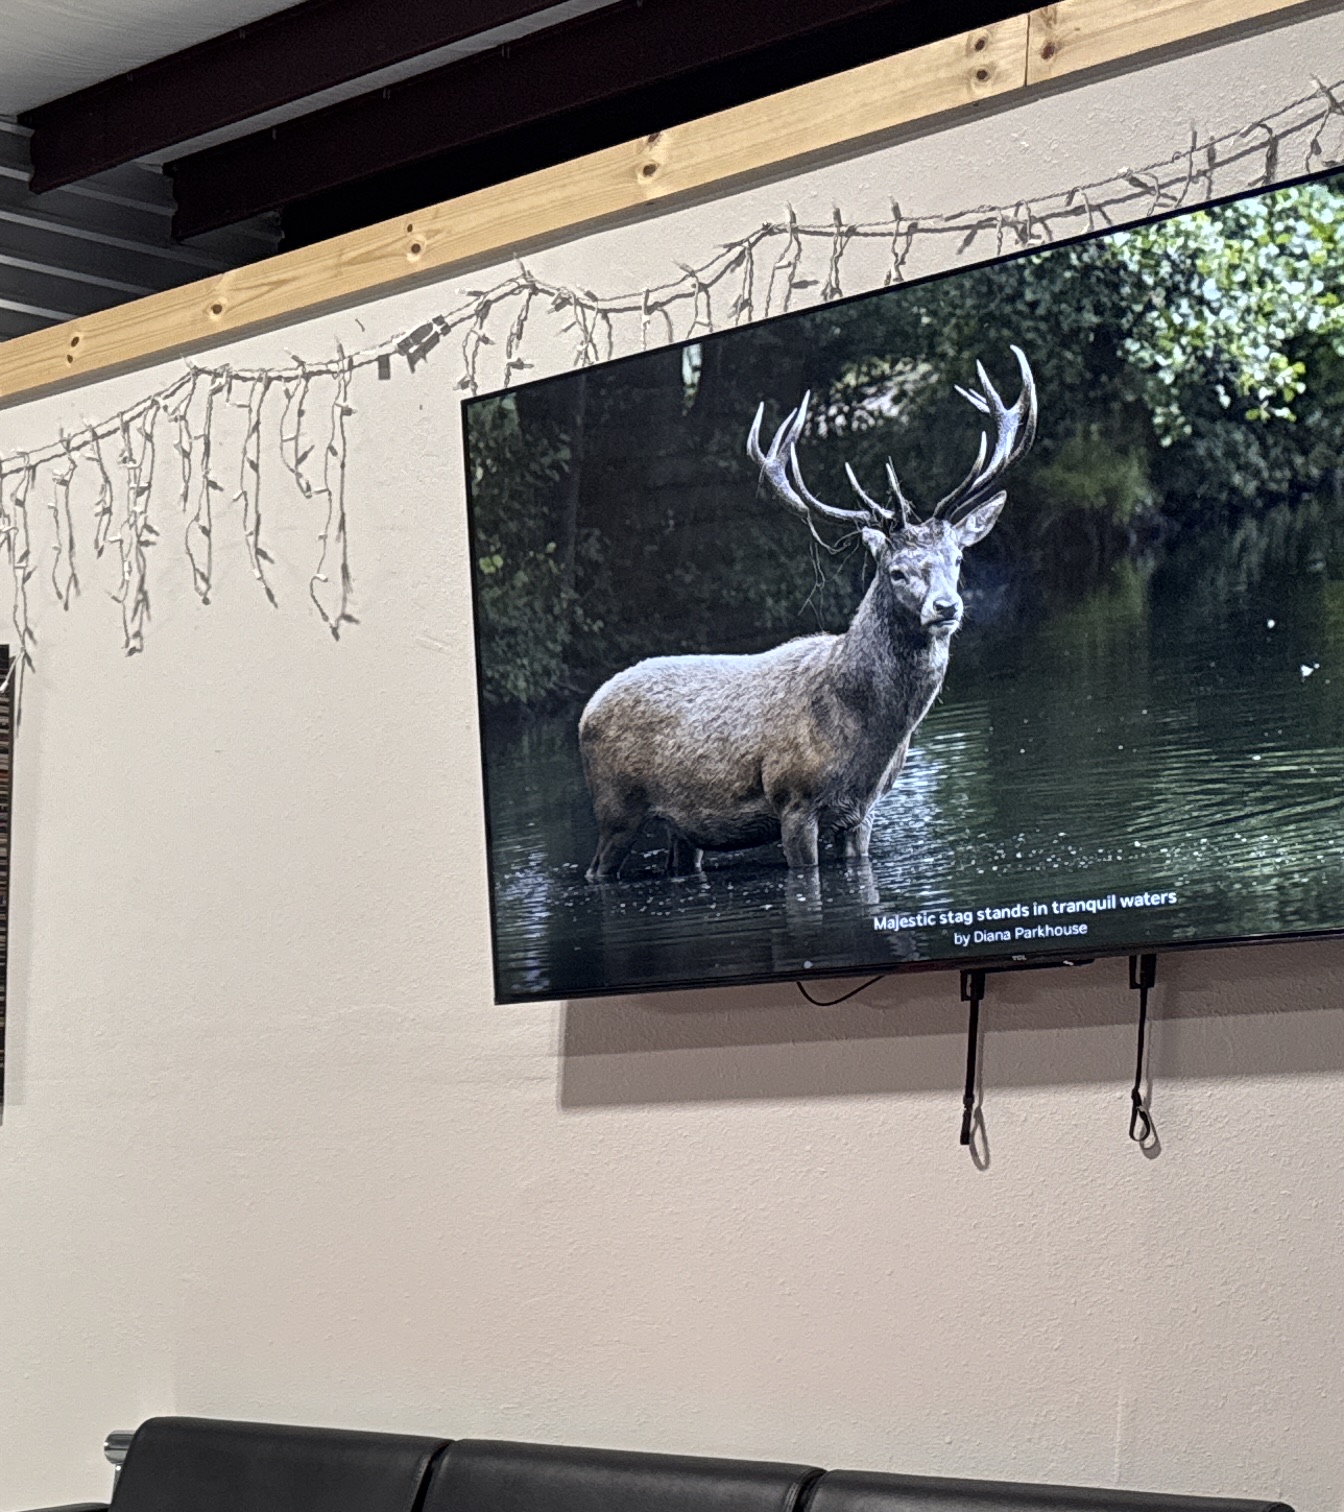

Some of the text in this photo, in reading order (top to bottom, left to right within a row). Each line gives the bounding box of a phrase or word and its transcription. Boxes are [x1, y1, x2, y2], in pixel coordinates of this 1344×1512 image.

[873, 891, 1177, 932] Majestic stag stands in tranquil waters
[954, 923, 1088, 947] by Diana Parkhouse
